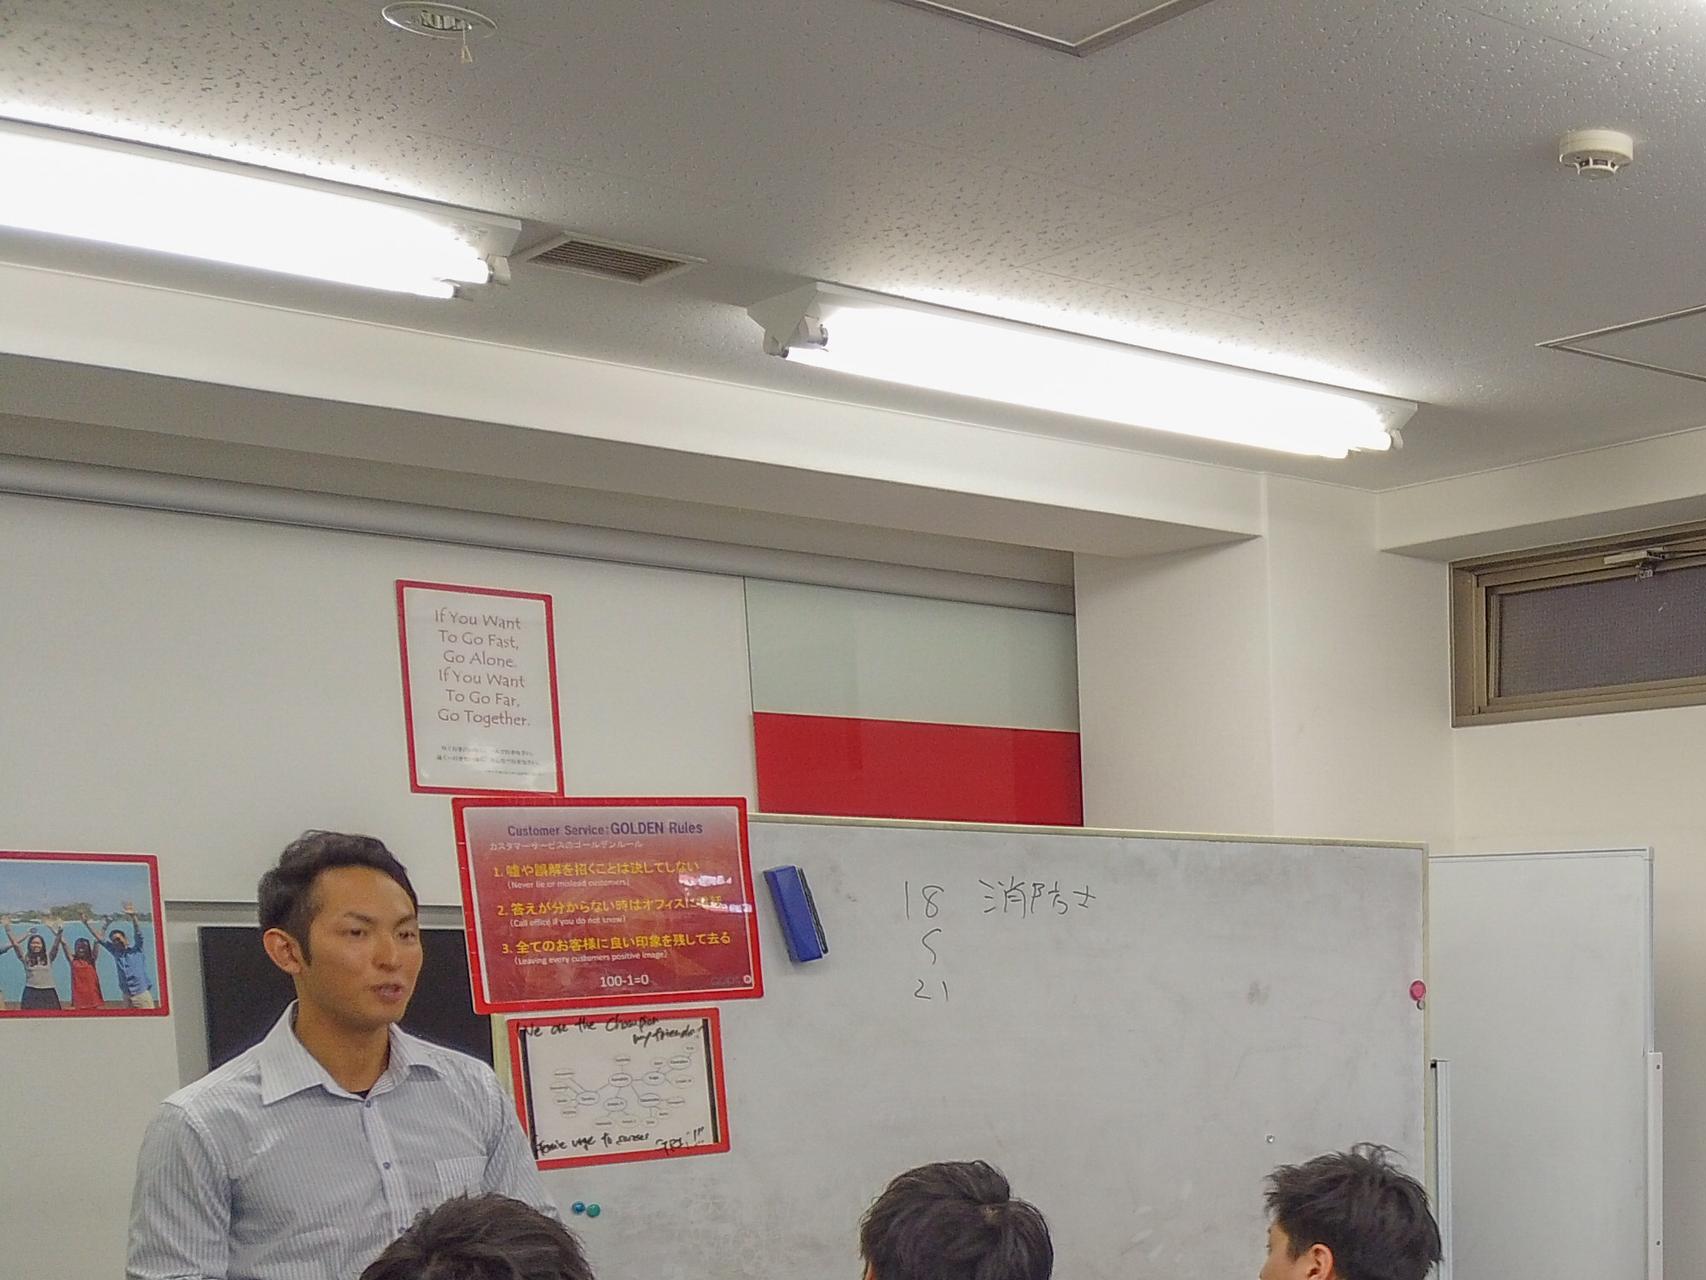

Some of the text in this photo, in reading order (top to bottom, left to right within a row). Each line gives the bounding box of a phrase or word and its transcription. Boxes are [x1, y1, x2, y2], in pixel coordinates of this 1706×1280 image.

[434, 607, 521, 630] If You Want
[438, 629, 457, 643] To
[462, 631, 484, 645] Go
[443, 650, 465, 663] Go
[438, 666, 525, 688] If You Want
[445, 689, 465, 702] To
[469, 691, 491, 704] Go
[438, 708, 530, 728] Go Together.
[507, 824, 560, 837] Customer
[611, 821, 664, 835] GOLDEN
[669, 821, 703, 834] Rules
[904, 881, 944, 920] 18
[600, 974, 649, 987] 100-1=0
[914, 979, 949, 1001] 21
